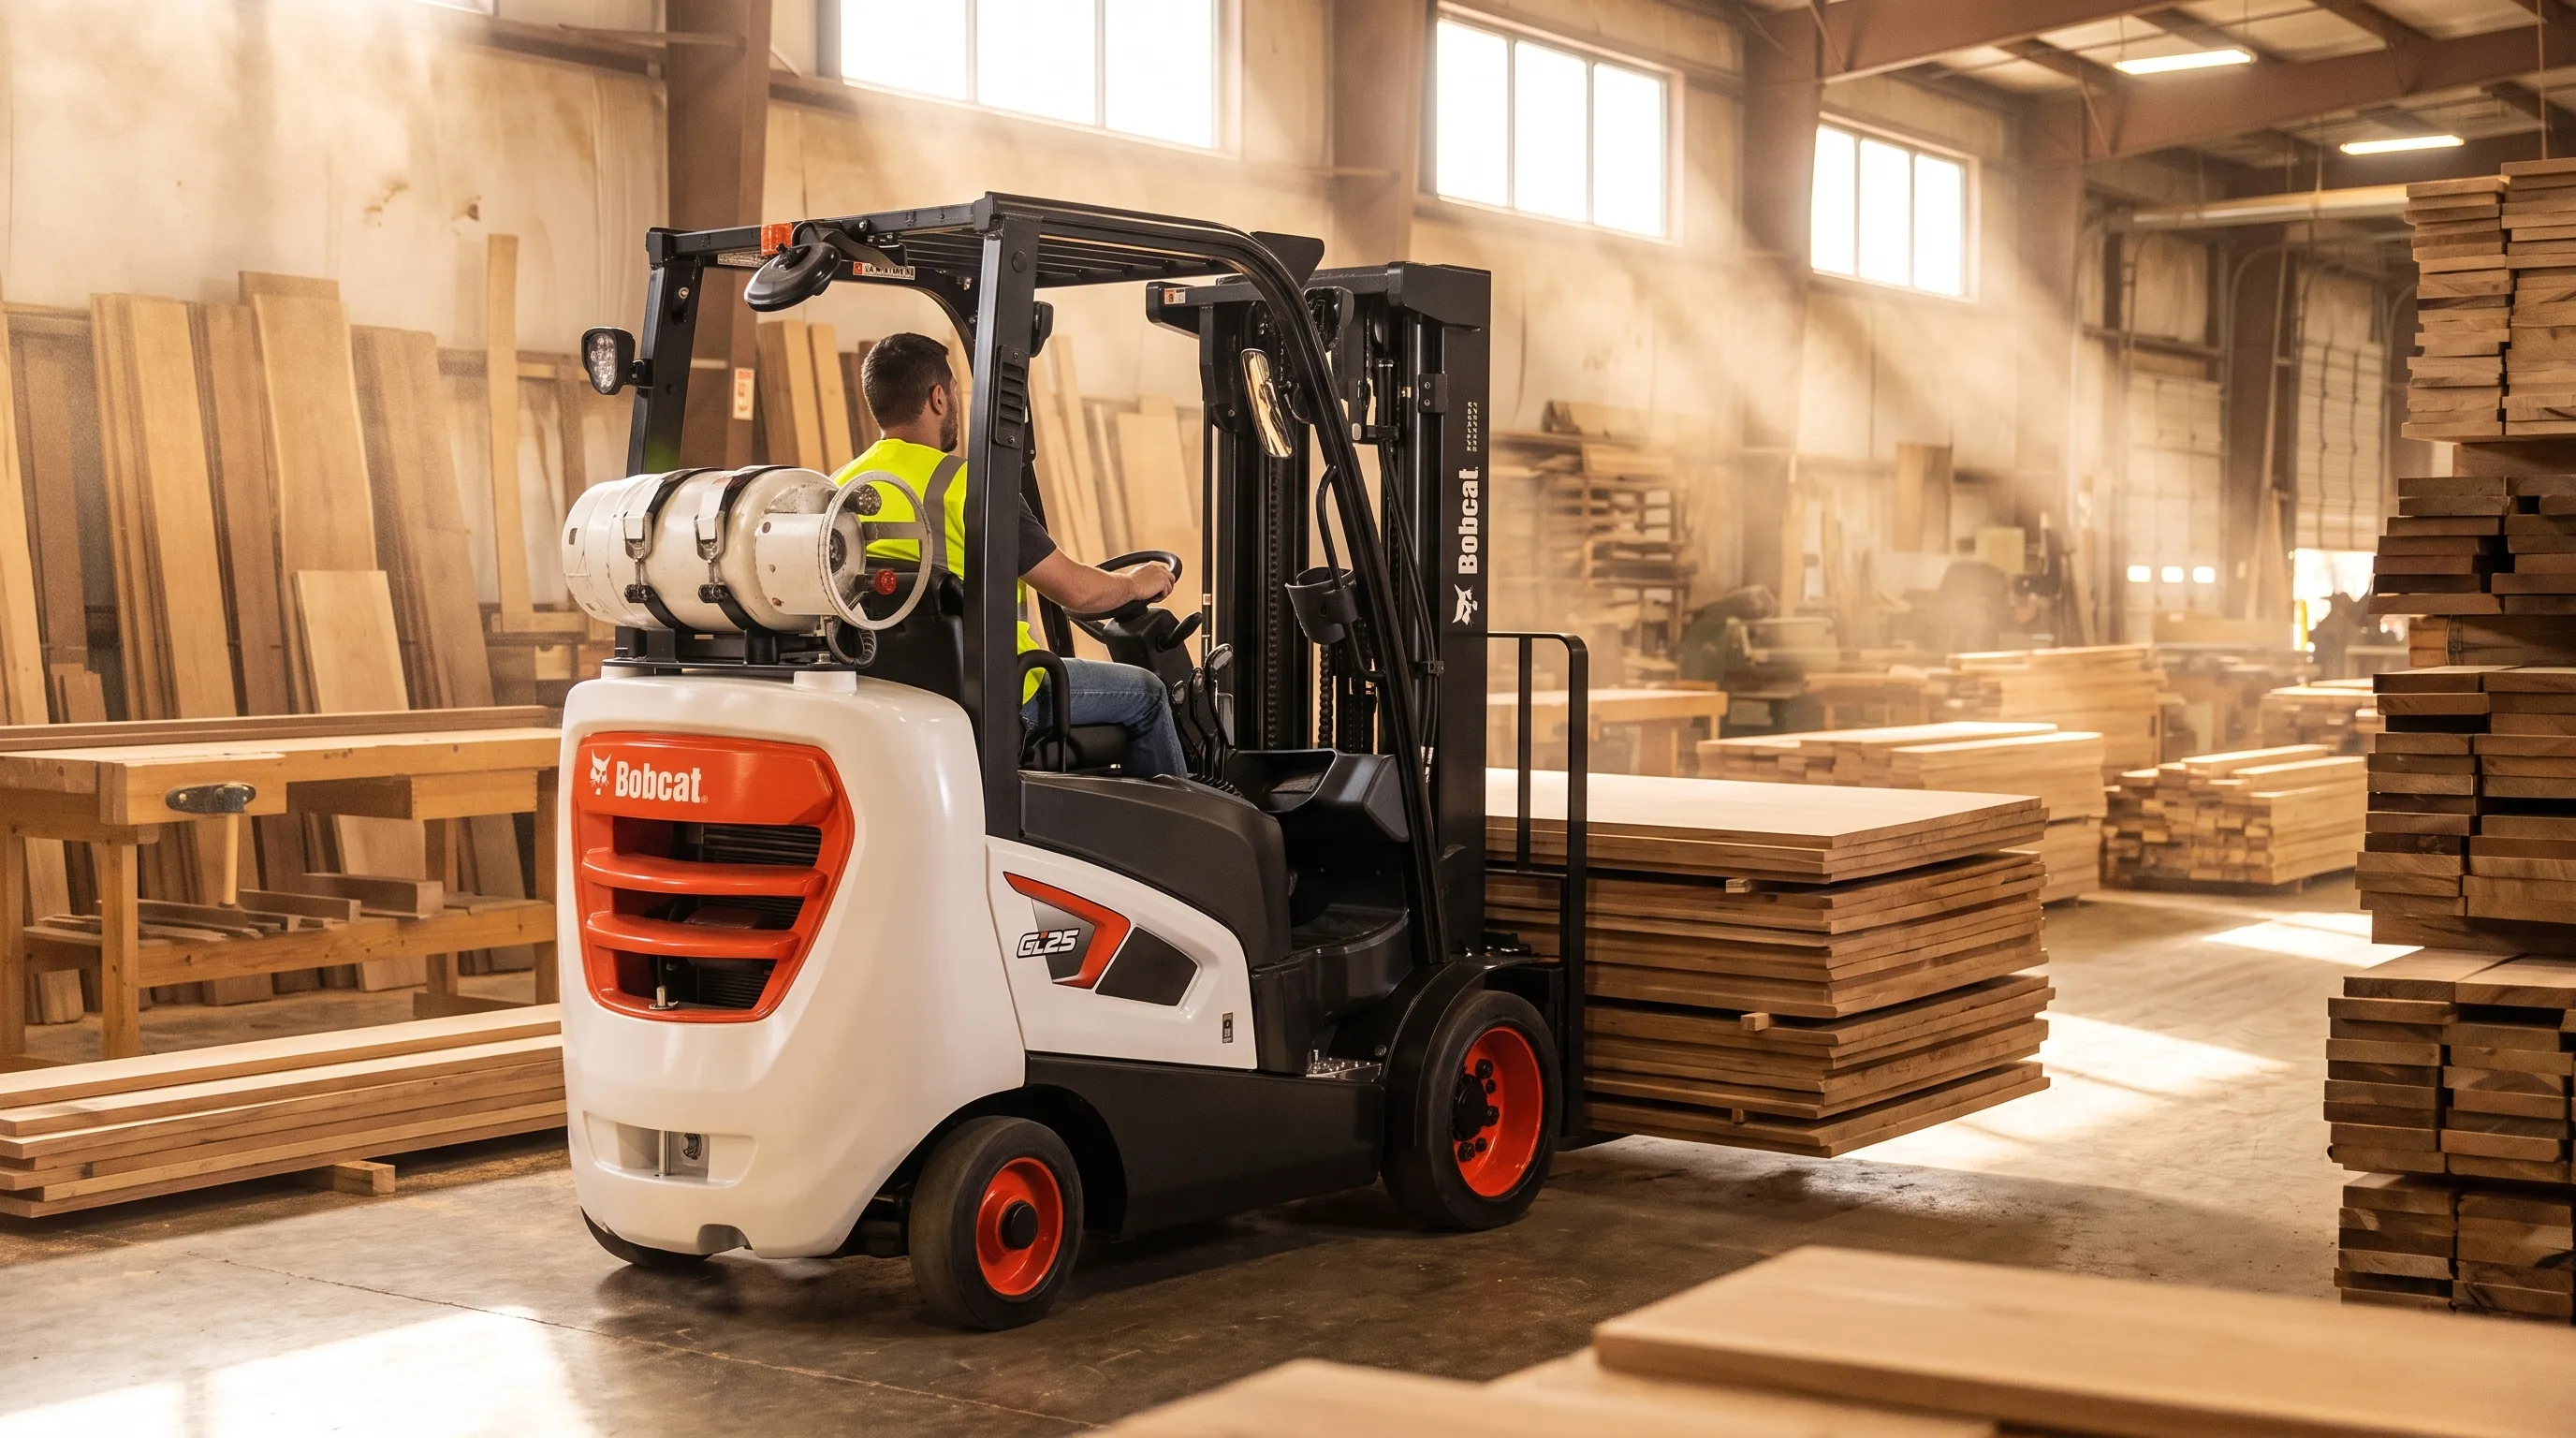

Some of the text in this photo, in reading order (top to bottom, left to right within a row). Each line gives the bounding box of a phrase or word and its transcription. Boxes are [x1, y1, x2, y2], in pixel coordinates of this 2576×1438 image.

[1458, 468, 1479, 574] Bobcat
[615, 760, 702, 803] Bobcat
[1017, 929, 1080, 957] GL25
